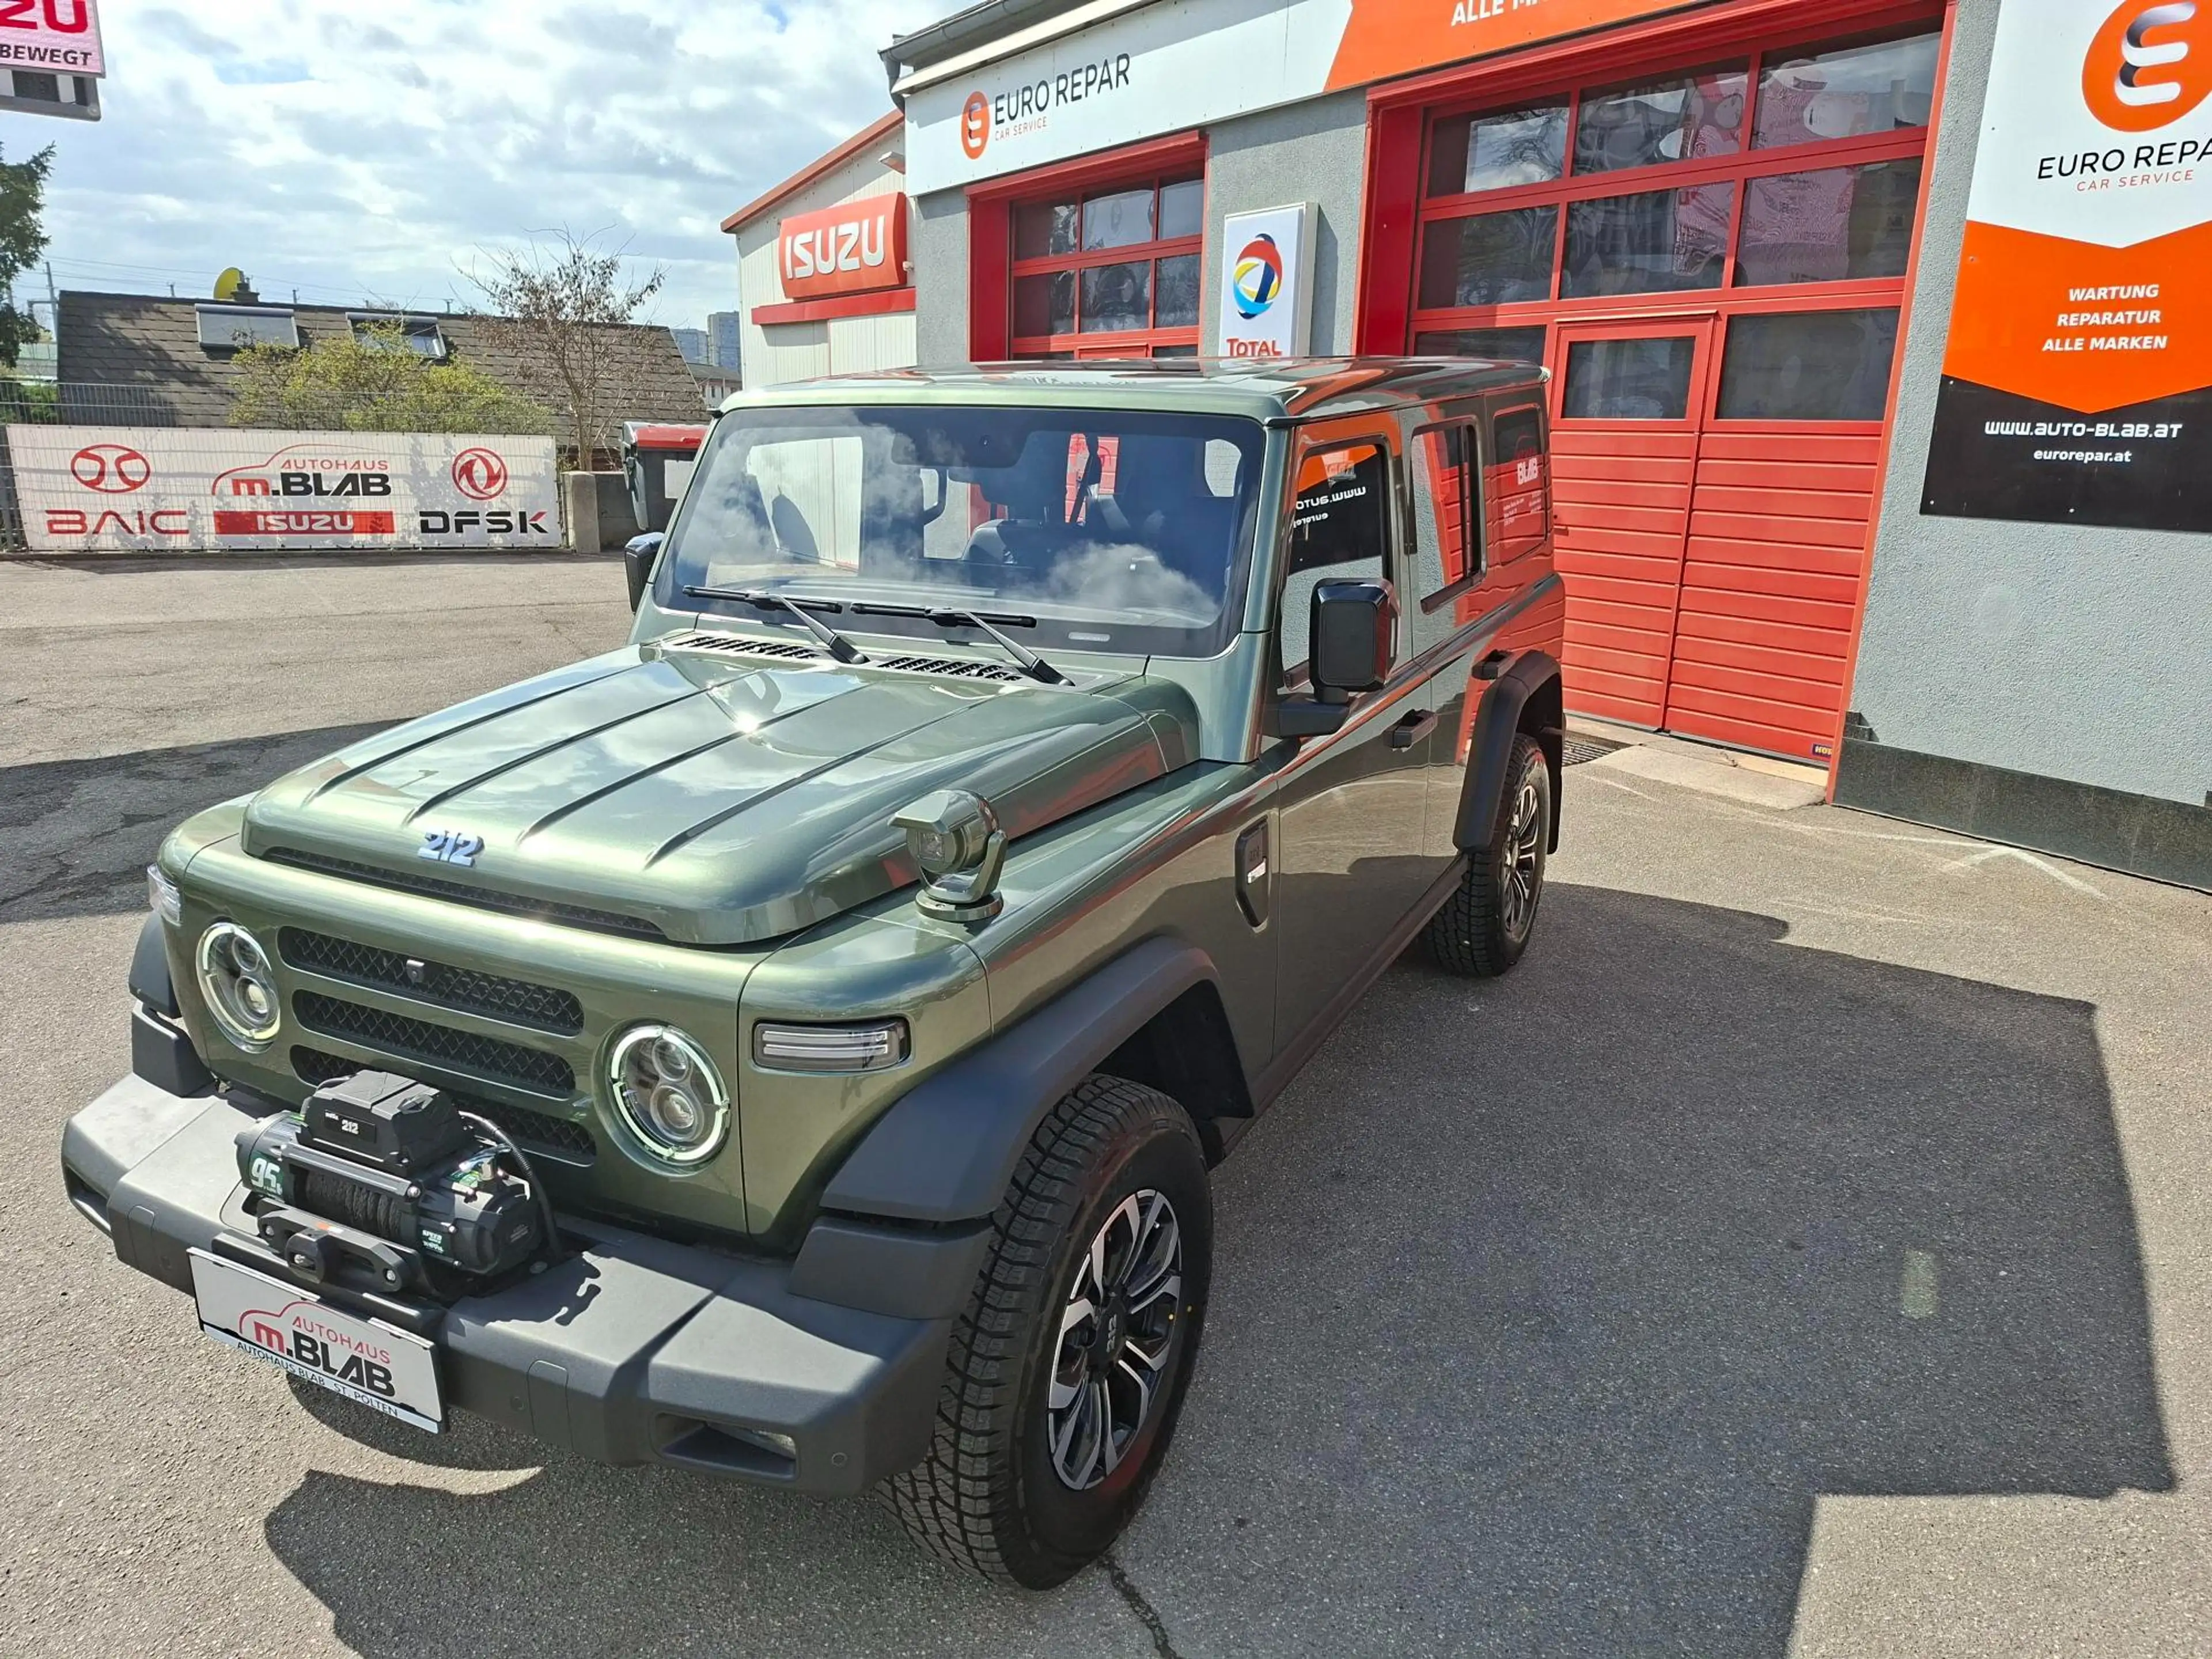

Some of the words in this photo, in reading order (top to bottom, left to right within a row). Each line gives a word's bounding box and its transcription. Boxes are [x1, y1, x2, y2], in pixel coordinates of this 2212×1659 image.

[1451, 0, 1505, 26] ALLE
[0, 44, 92, 66] BEWEGT
[995, 79, 1050, 126] EURO
[1056, 53, 1130, 107] REPAR
[995, 127, 1010, 141] CAR
[1013, 116, 1048, 136] SERVICE
[2037, 149, 2125, 180] EURO
[2077, 179, 2110, 191] CAR
[2118, 169, 2194, 188] SERVICE
[785, 214, 885, 279] ISUZU
[2069, 284, 2160, 302] WARTUNG
[2056, 309, 2161, 327] REPARATUR
[1226, 338, 1283, 357] TOTAL
[2041, 338, 2085, 352] ALLE
[2089, 335, 2168, 350] MARKEN
[281, 459, 388, 471] AUTOHAUS
[2033, 449, 2133, 464] eurorepar.at
[45, 510, 190, 535] BAIC
[257, 514, 355, 531] ISUZU
[419, 510, 549, 534] DFSK
[418, 831, 485, 867] 212
[342, 1119, 359, 1134] 212
[292, 1316, 391, 1363] AUTOHAUS
[237, 1342, 297, 1373] AUTOHAUS
[298, 1368, 325, 1385] BLAB
